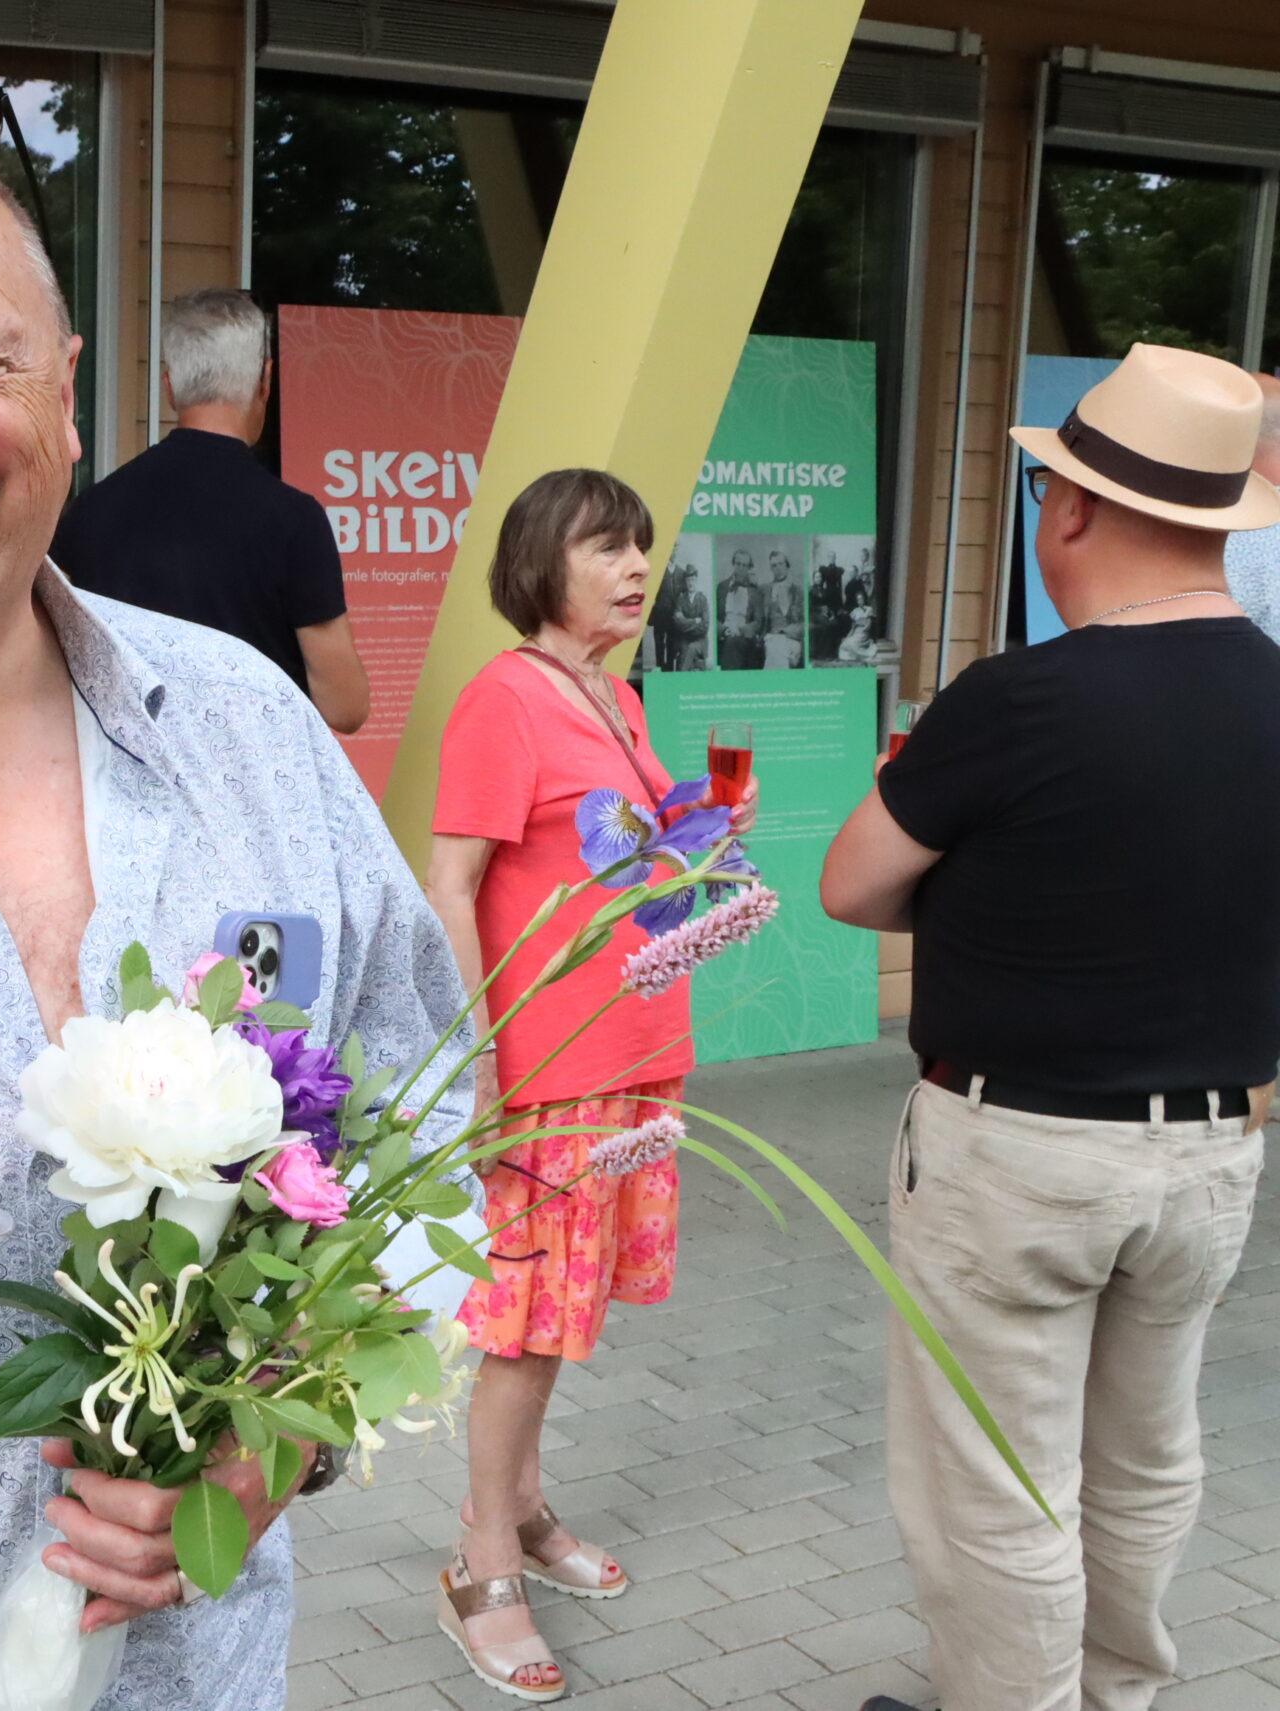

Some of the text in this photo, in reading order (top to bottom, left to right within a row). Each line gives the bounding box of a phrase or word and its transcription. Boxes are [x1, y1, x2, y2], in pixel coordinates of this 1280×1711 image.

[323, 449, 479, 499] SKeiV
[698, 460, 847, 487] OMANTiSKe
[343, 568, 368, 582] mle
[372, 568, 438, 585] fotografier,
